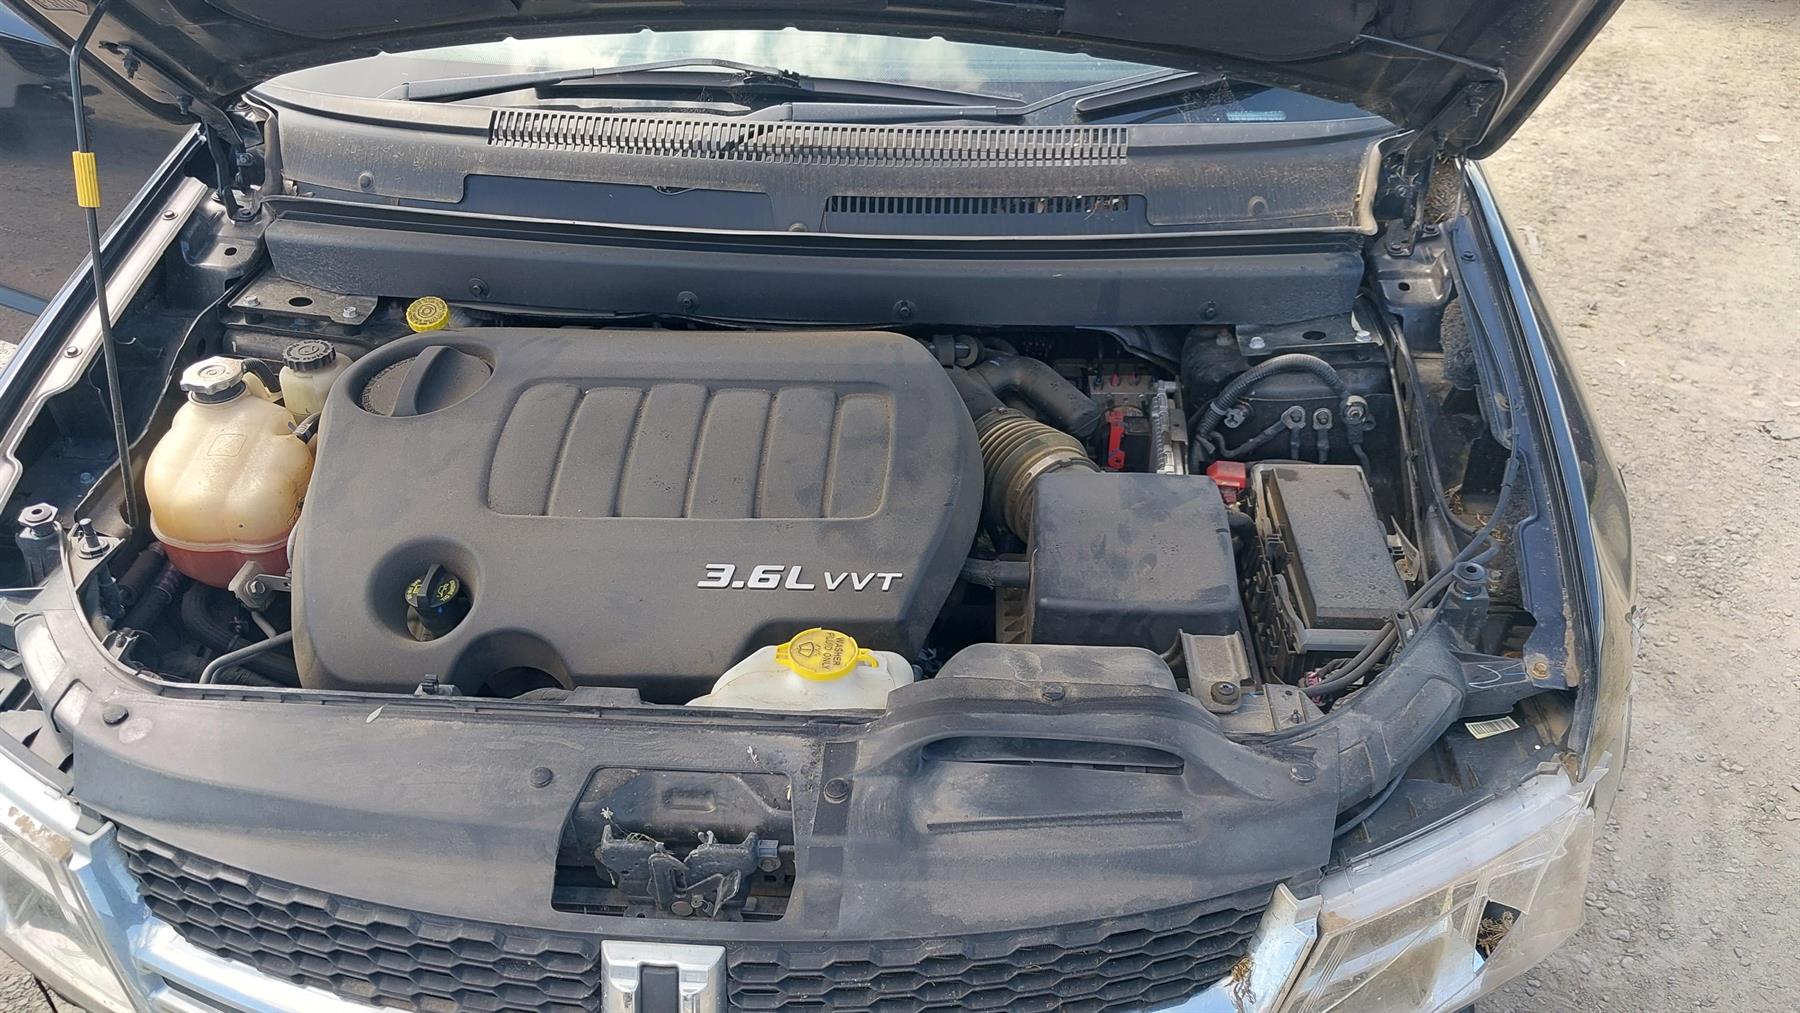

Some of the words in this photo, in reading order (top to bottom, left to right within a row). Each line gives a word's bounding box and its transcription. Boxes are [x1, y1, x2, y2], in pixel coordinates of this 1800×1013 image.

[697, 563, 815, 590] 3.6L
[823, 571, 904, 592] VVT
[824, 632, 836, 651] FLUID
[832, 637, 845, 666] WASHER
[822, 652, 833, 670] ONLY
